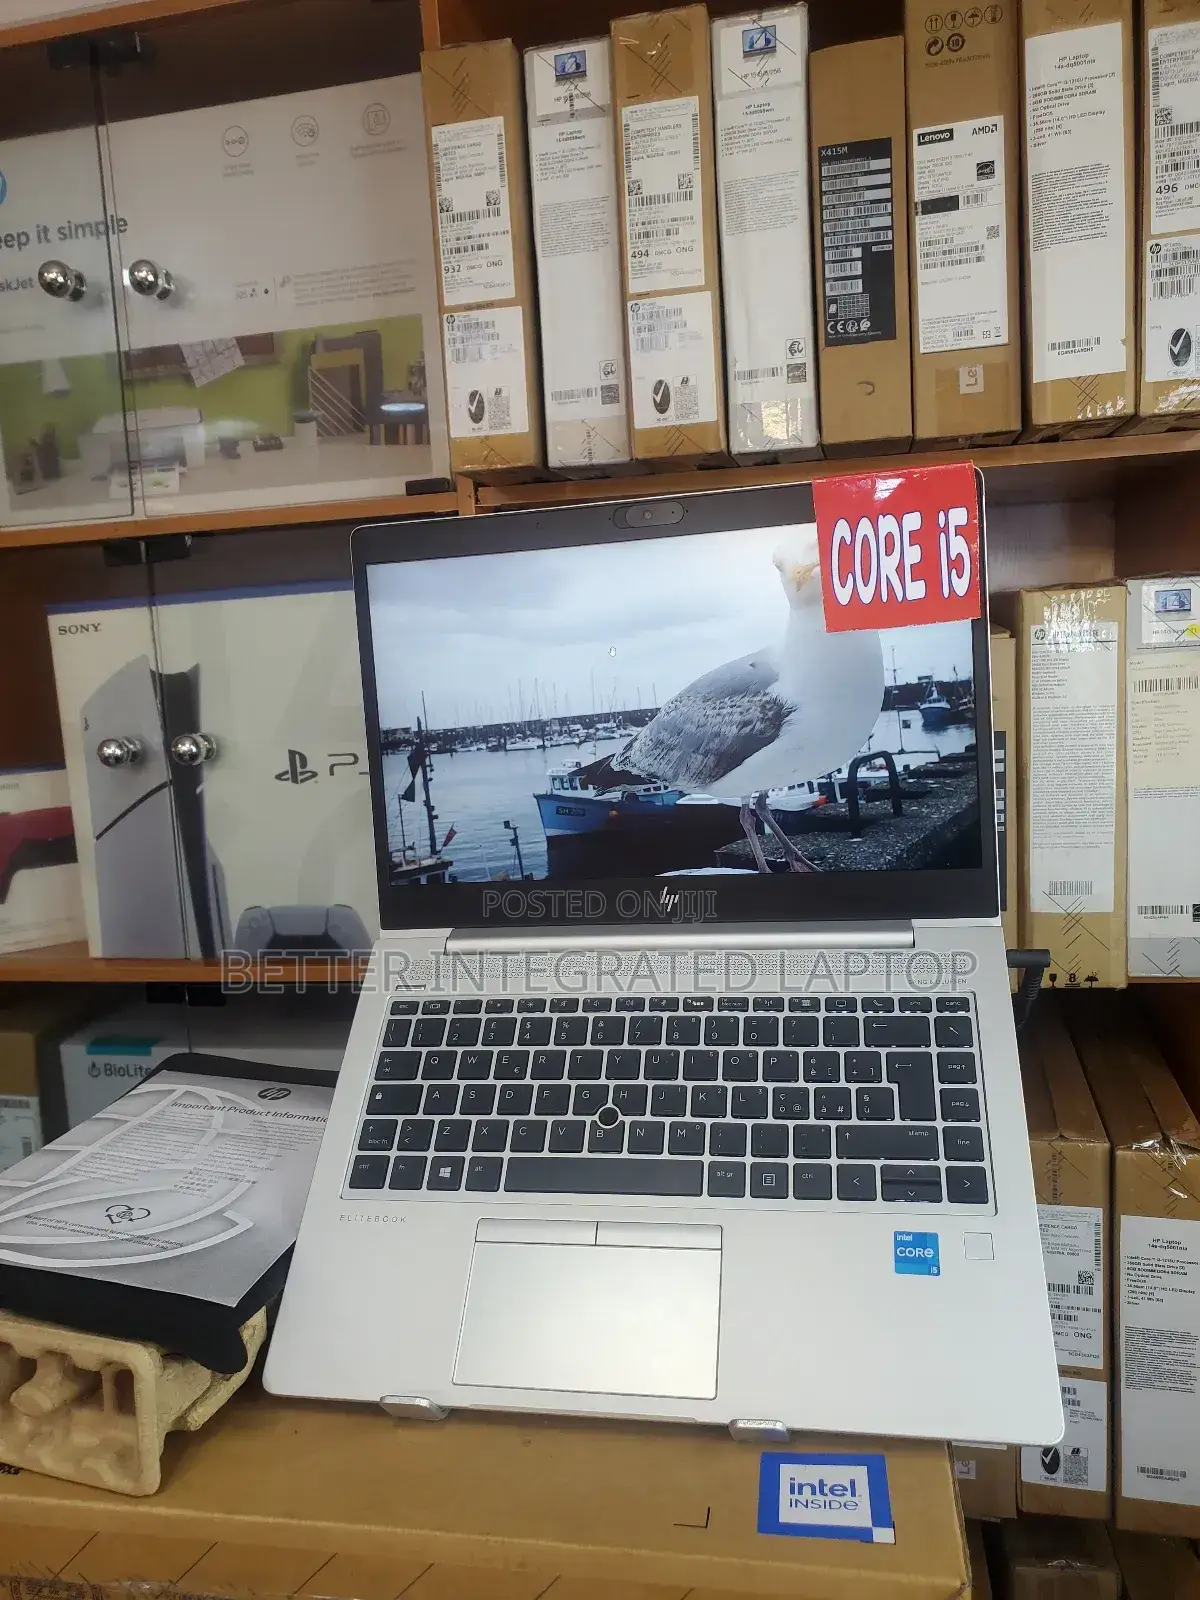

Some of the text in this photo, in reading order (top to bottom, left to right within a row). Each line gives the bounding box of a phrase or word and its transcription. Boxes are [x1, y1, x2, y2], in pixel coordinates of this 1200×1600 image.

[1068, 53, 1089, 61] Laptop
[1084, 73, 1108, 81] Processor
[630, 123, 682, 134] COMPETENT HANDLERS
[971, 125, 990, 136] AMD
[630, 132, 660, 140] ENTERPRISES
[920, 132, 950, 142] Lenovo
[821, 146, 848, 157] X415M
[1155, 182, 1200, 194] 496 DMC
[0, 214, 128, 251] ep it simple
[631, 249, 649, 259] 494
[444, 264, 461, 274] 932
[486, 260, 503, 268] ONG
[831, 506, 972, 606] CORE i5
[58, 622, 102, 636] SONY
[452, 1033, 459, 1041] 2
[430, 1056, 439, 1065] Q
[467, 1056, 478, 1064] W
[502, 1056, 509, 1064] E
[538, 1056, 546, 1064] R
[652, 1056, 660, 1064] U
[730, 1056, 740, 1065] O
[770, 1057, 777, 1065] P
[104, 1062, 151, 1078] BioLite
[582, 1090, 590, 1098] G
[699, 1092, 706, 1101] K
[171, 1101, 226, 1112] Important
[227, 1106, 271, 1118] Product
[792, 1103, 844, 1113] @ #
[442, 1127, 450, 1135] Z
[481, 1126, 489, 1135] X
[519, 1127, 527, 1135] C
[558, 1127, 566, 1135] V
[596, 1129, 604, 1138] B
[636, 1128, 644, 1137] N
[677, 1129, 686, 1138] M
[339, 1214, 407, 1224] ELITEBOOK
[38, 1223, 67, 1231] envelope
[896, 1233, 913, 1241] intel
[1073, 1331, 1092, 1339] ONG
[789, 1476, 857, 1498] intel
